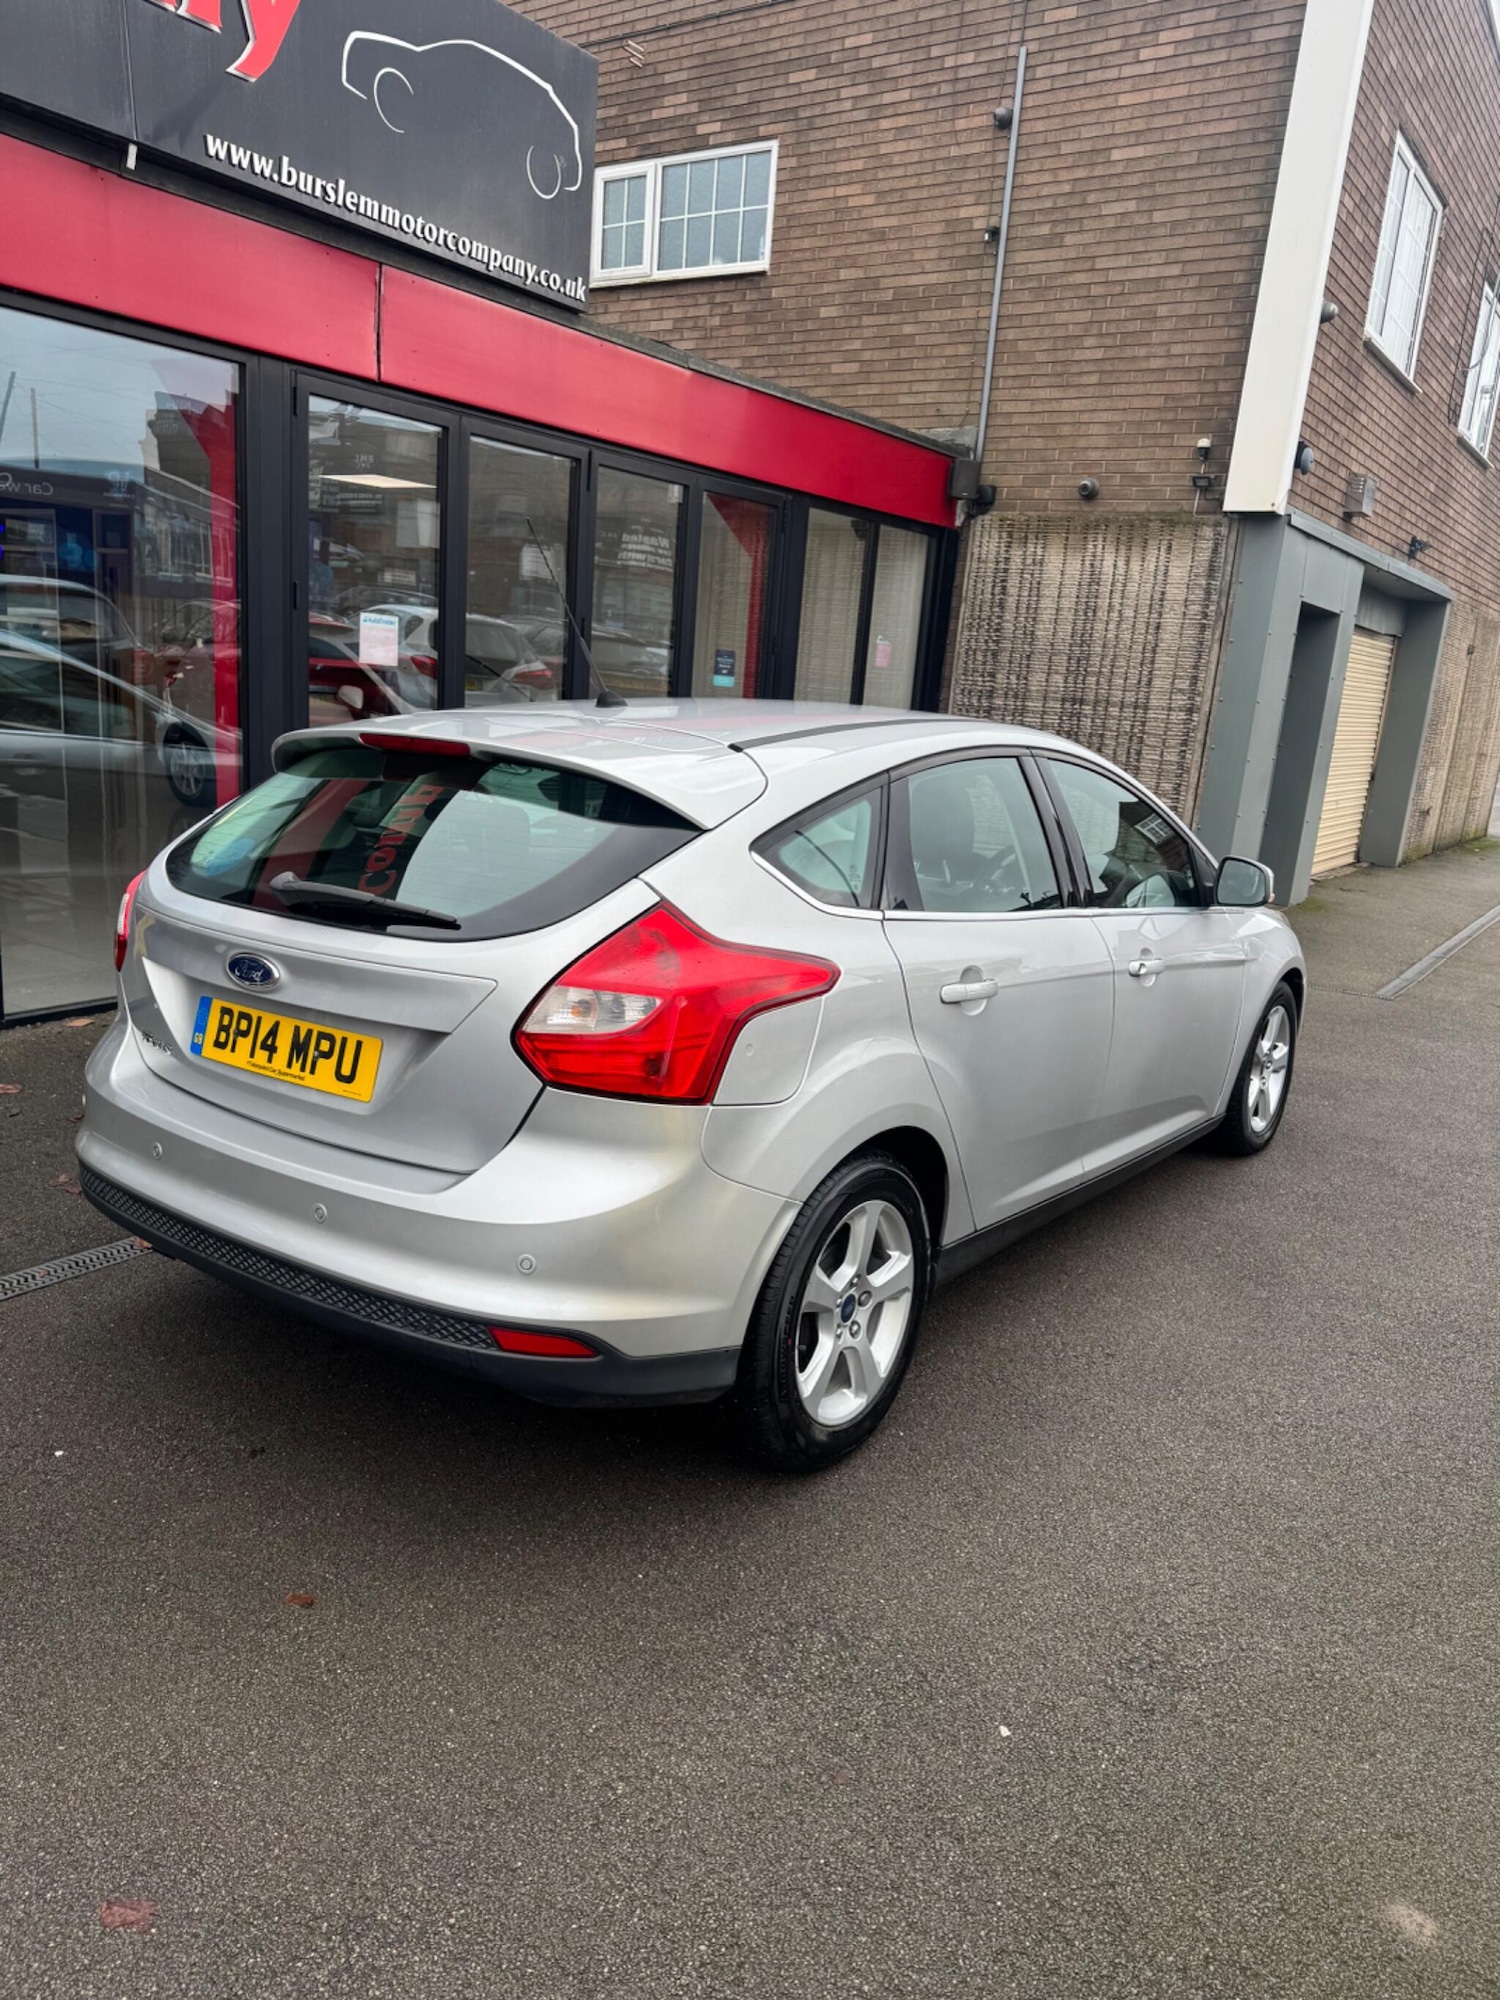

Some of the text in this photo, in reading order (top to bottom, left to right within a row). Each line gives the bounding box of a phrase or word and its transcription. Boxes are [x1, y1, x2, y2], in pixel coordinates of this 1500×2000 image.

[204, 133, 587, 303] www.burslemmotorcompany.co.uk
[234, 958, 264, 982] Ford
[213, 1006, 363, 1084] BP14 MPU
